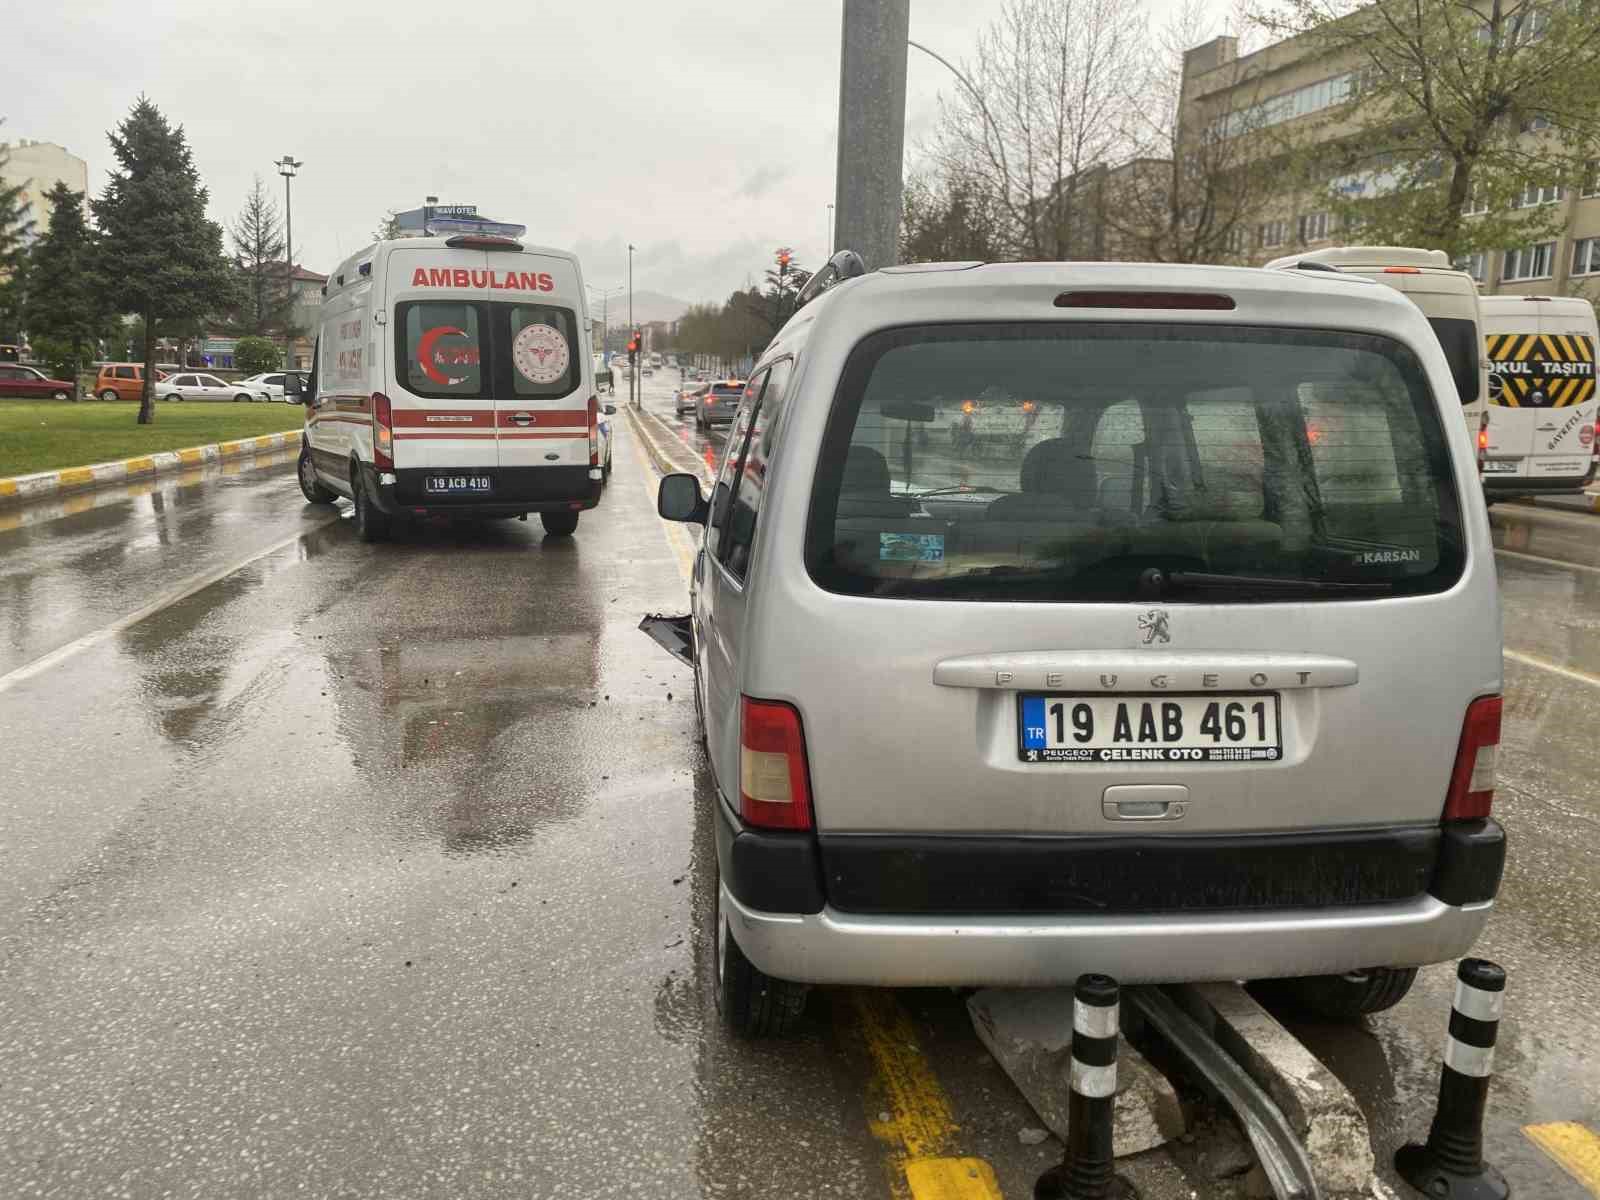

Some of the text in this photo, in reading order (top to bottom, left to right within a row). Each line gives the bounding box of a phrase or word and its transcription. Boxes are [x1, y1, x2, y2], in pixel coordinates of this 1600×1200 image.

[411, 268, 554, 292] AMBULANS
[433, 478, 488, 489] 19 ACB 410
[1363, 550, 1420, 563] KARSAN
[995, 671, 1311, 689] PEUGEOT
[1050, 702, 1266, 743] 19 AAB 461
[1027, 727, 1045, 740] TR
[1042, 749, 1097, 757] PEUGEOT
[1100, 749, 1165, 761] ÇELENK
[1168, 748, 1203, 760] OTO
